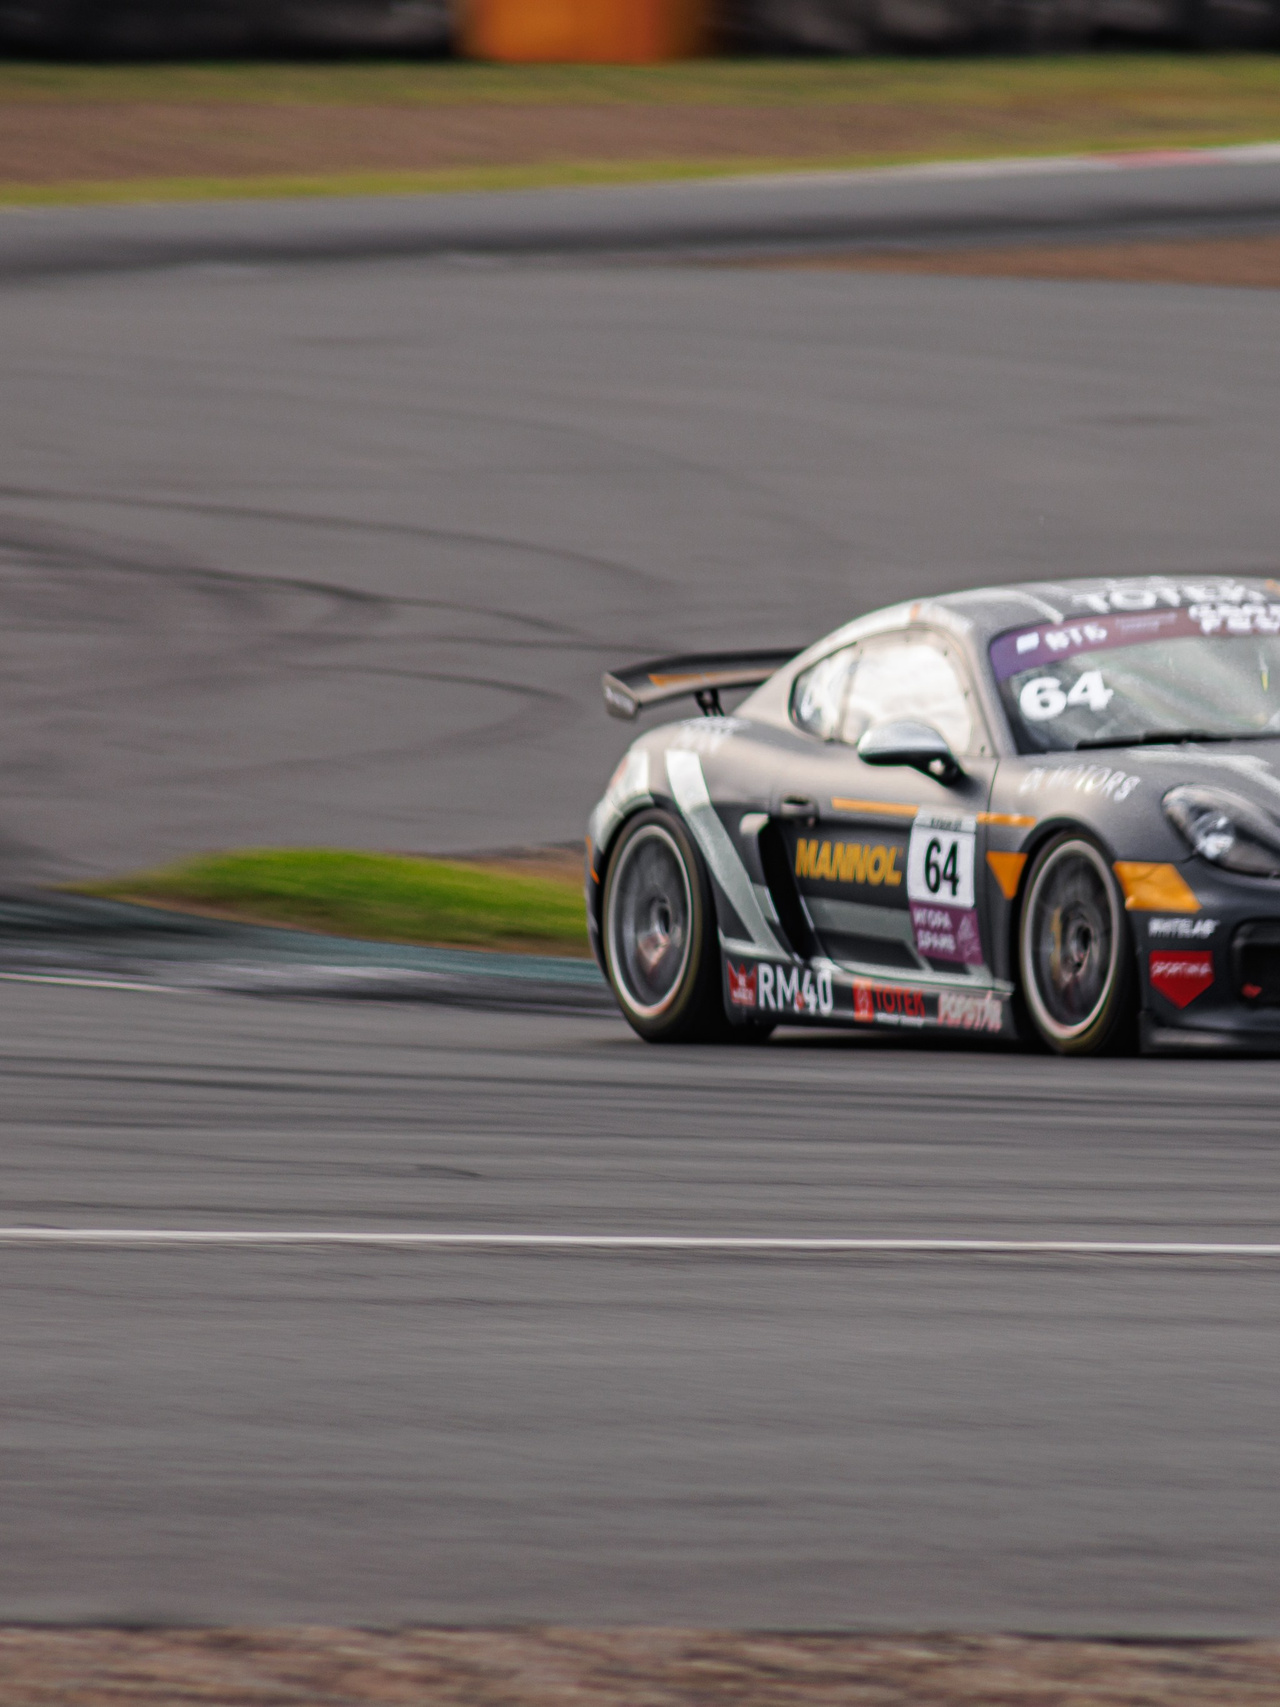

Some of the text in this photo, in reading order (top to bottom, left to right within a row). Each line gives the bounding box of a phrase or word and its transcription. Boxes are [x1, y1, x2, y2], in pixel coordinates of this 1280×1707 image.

[1019, 670, 1114, 722] 64
[795, 838, 902, 887] MANNOL
[925, 838, 960, 896] 64
[873, 984, 926, 1018] TOTEK
